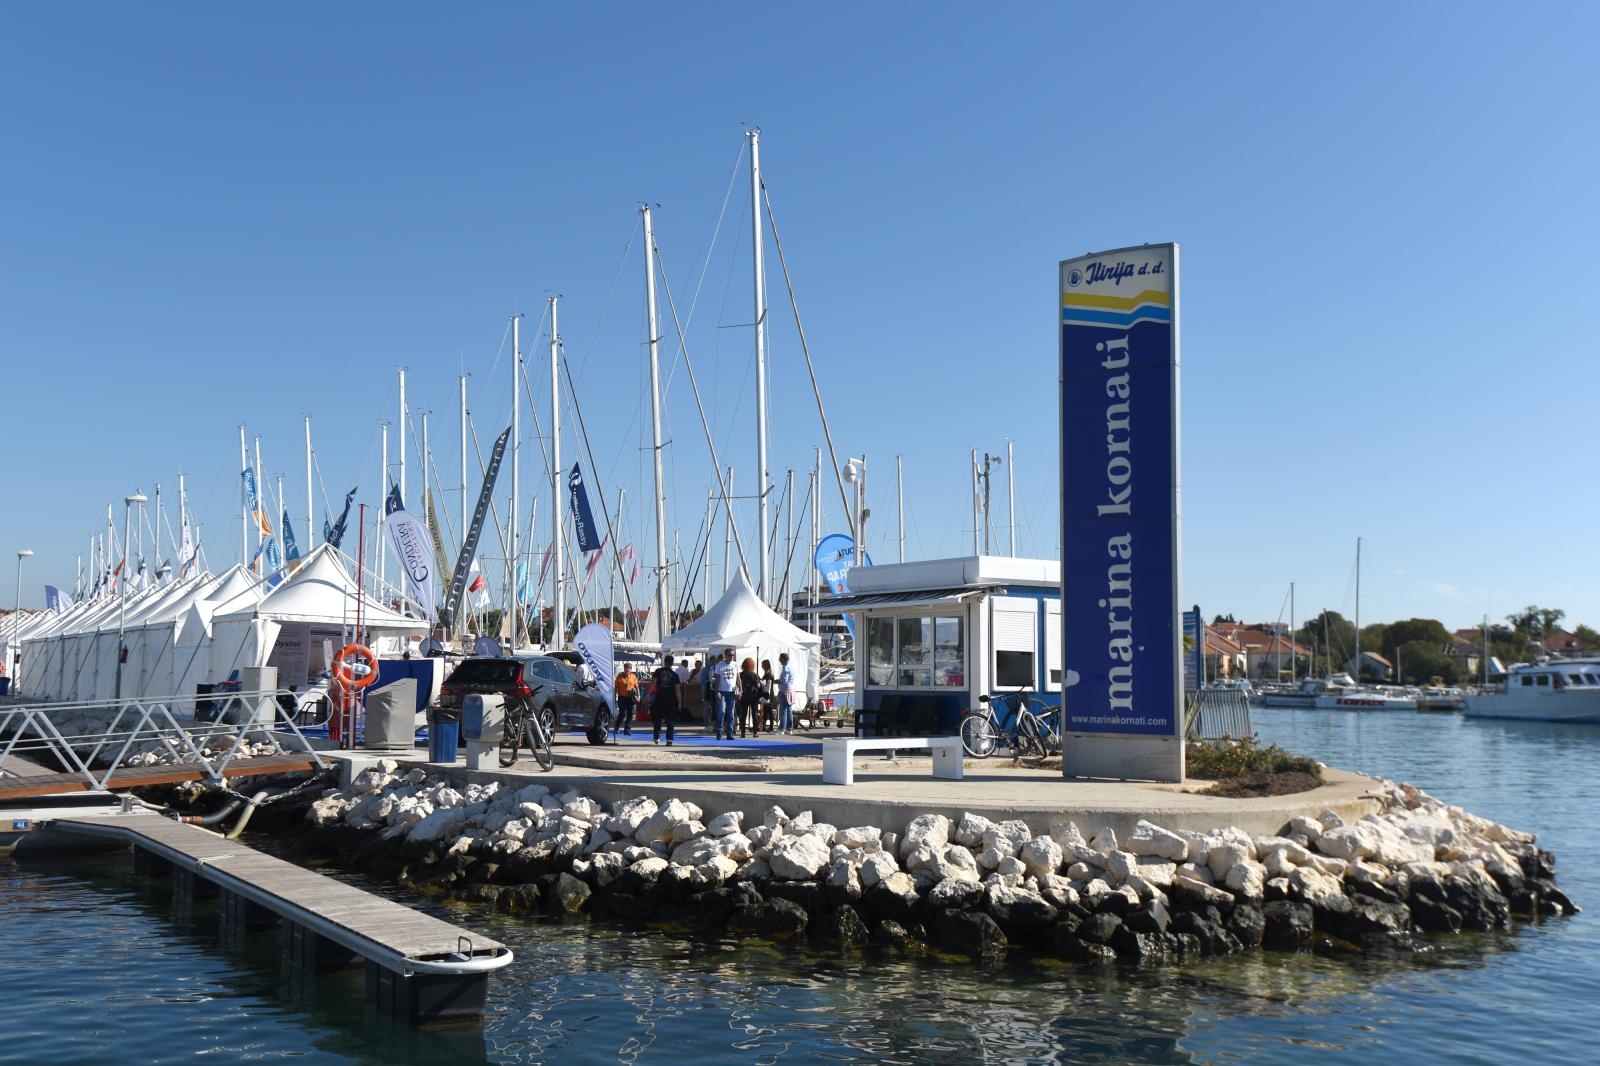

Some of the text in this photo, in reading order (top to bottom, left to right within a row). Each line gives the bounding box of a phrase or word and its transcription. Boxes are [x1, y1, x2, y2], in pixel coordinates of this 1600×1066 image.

[1096, 335, 1133, 711] marina kornati
[1071, 715, 1168, 727] www.marinakornati.com
